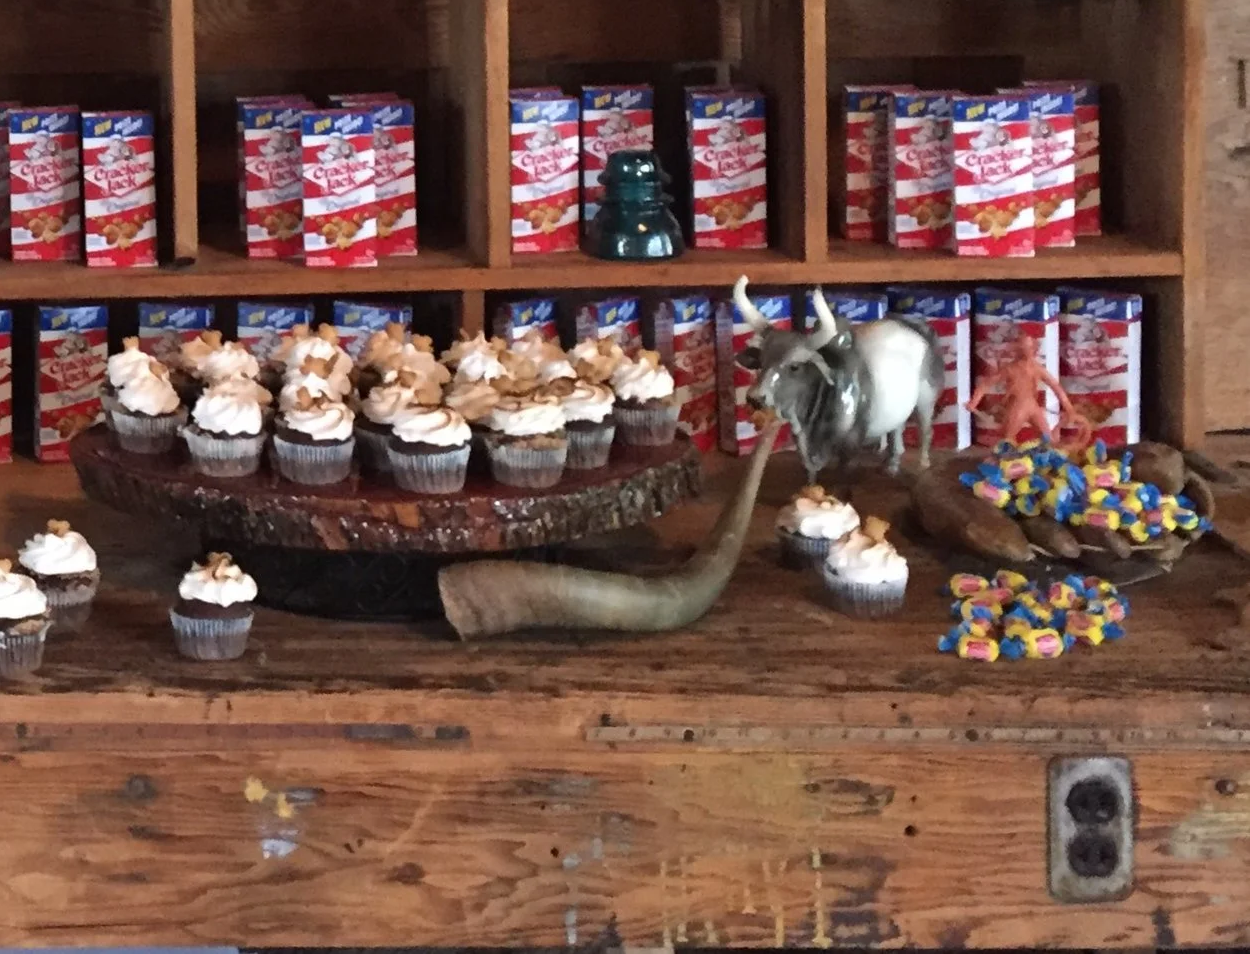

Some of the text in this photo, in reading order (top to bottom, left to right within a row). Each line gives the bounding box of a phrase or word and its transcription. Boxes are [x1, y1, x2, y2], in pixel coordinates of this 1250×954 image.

[521, 147, 573, 167] Cracker
[704, 143, 760, 163] Cracker
[966, 148, 1026, 167] Cracker
[94, 162, 150, 181] Cracker
[313, 160, 370, 180] Cracker
[981, 163, 1014, 179] Jack
[108, 176, 138, 193] Jack
[327, 175, 359, 192] Jack
